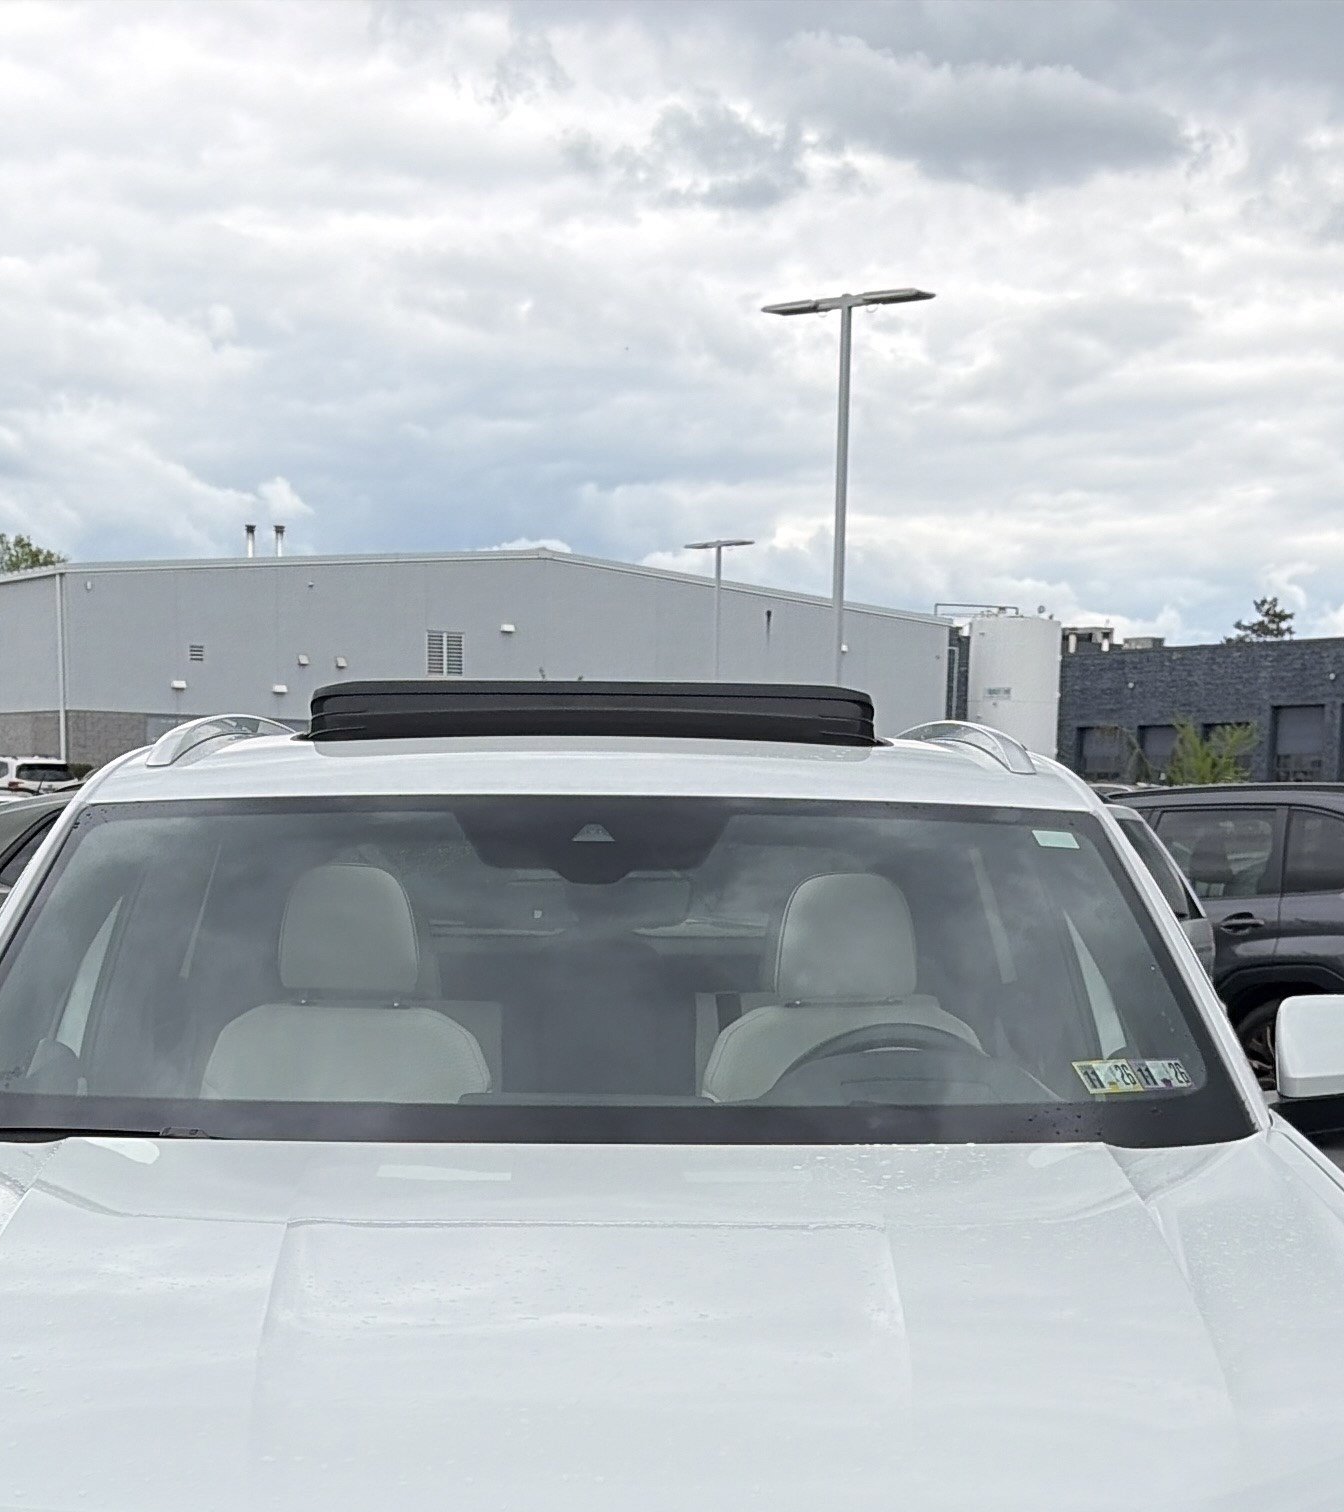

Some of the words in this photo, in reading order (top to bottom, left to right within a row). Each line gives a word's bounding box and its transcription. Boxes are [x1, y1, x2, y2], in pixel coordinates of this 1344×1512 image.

[1082, 1067, 1105, 1089] 11
[1114, 1063, 1137, 1086] 26
[1136, 1066, 1159, 1087] 11
[1167, 1062, 1192, 1084] 26
